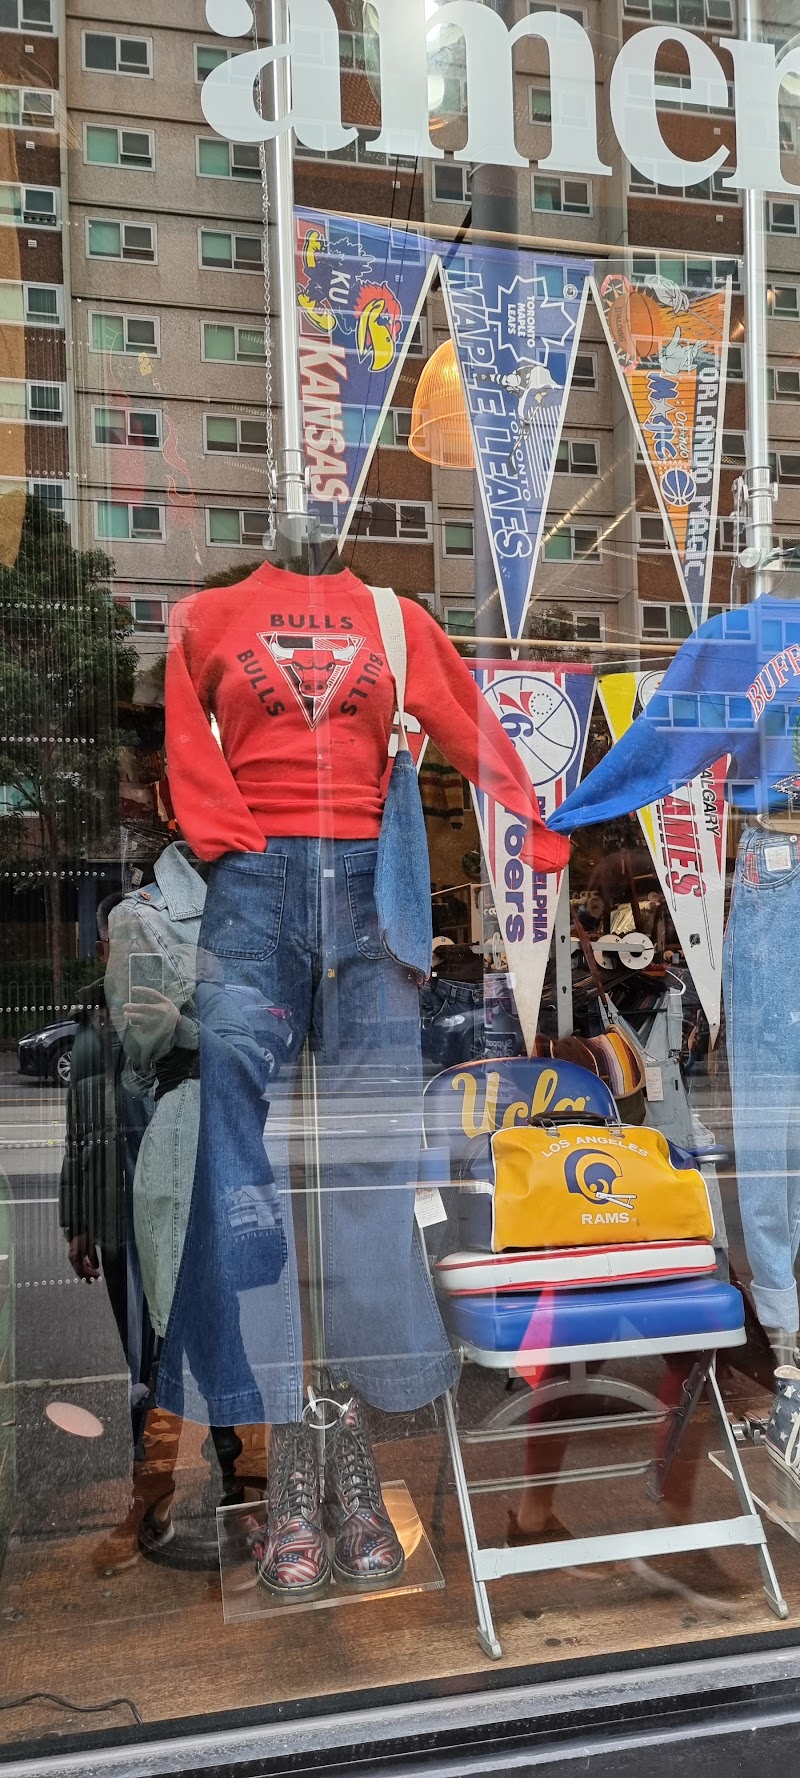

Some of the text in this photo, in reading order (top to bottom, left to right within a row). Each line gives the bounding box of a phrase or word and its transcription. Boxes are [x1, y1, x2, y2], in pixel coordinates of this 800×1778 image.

[328, 269, 351, 305] KU
[507, 303, 517, 335] LEAFS
[517, 302, 526, 338] MAPLE
[526, 295, 536, 348] TORONTO
[299, 337, 349, 504] KANSAS
[443, 268, 532, 558] MAPLE LEAFS
[508, 408, 531, 502] TORONTO
[684, 366, 719, 577] ORLANDO MAGIC
[270, 613, 354, 630] BULLS
[236, 649, 285, 717] BULLS
[340, 652, 384, 717] BULLS
[700, 765, 720, 837] ALGARY
[656, 784, 707, 897] AMES
[540, 1135, 649, 1158] LOS ANGELES
[581, 1213, 630, 1225] RAMS
